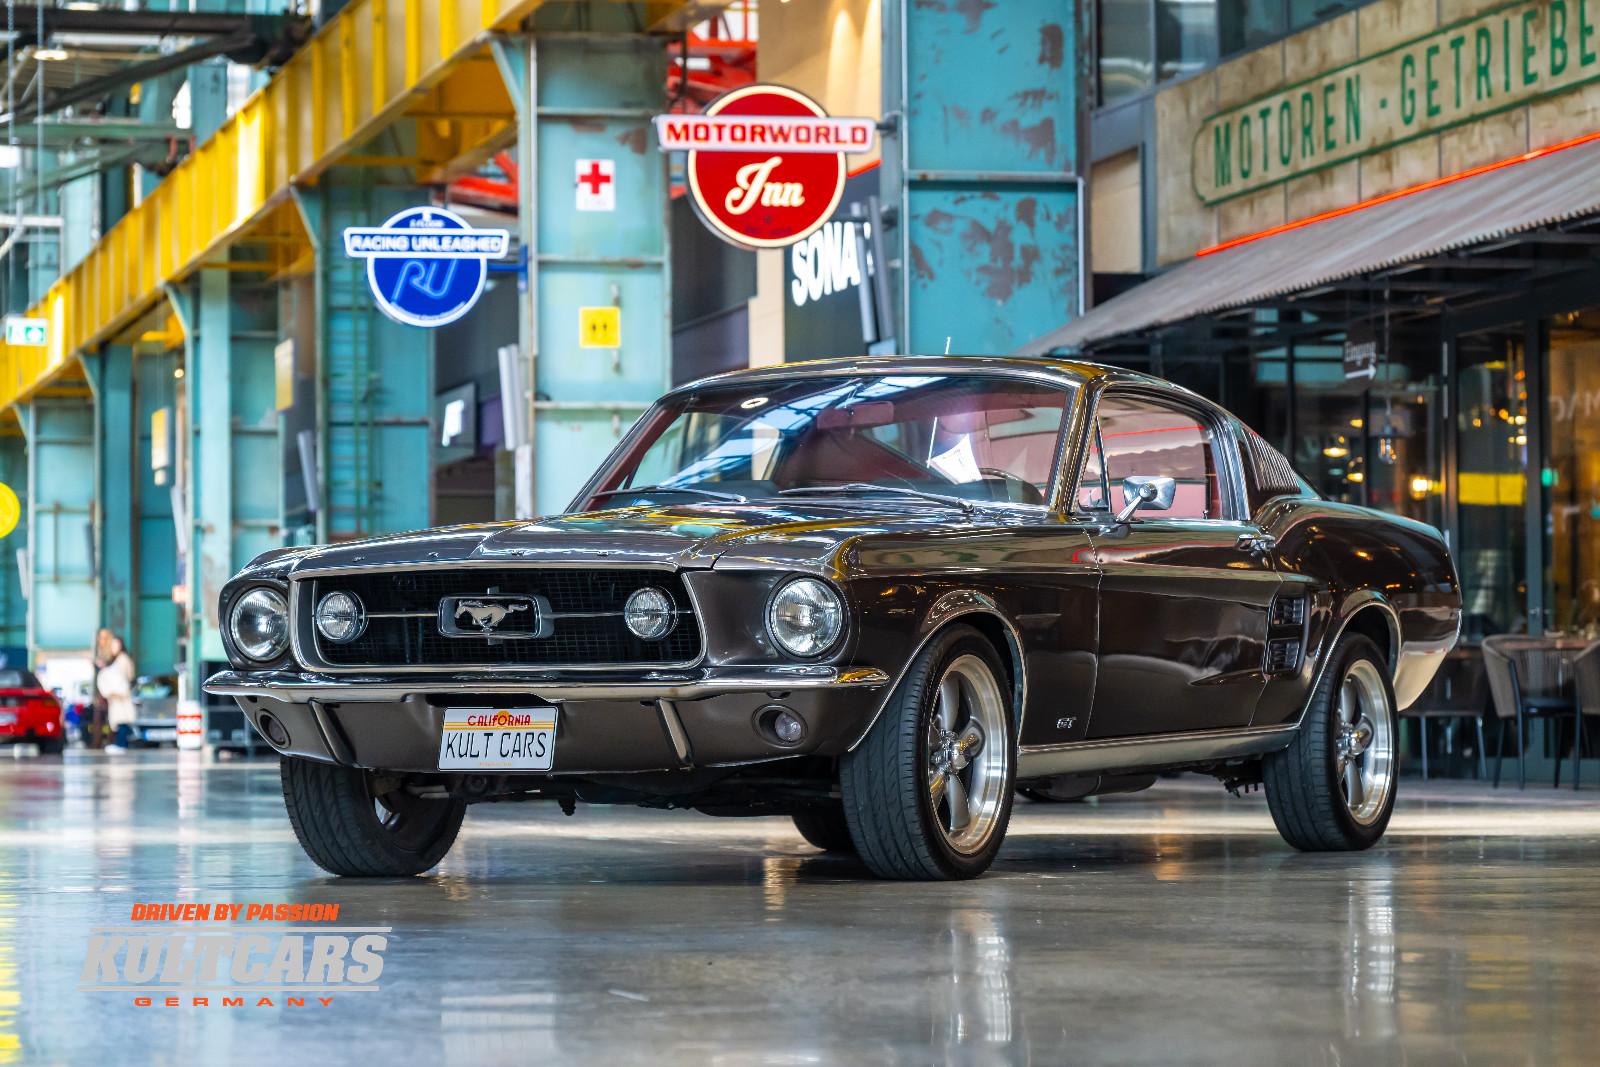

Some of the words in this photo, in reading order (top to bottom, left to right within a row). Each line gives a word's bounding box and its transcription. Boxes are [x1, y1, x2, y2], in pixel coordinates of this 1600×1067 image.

[1214, 74, 1360, 188] MOTOREN
[1401, 0, 1597, 126] GETRIEBE
[666, 123, 867, 144] MOTORWORLD
[725, 156, 805, 215] Inn
[351, 235, 409, 251] RACING
[411, 236, 501, 251] UNLEASHED
[467, 714, 531, 727] CALIFORNIA
[445, 732, 493, 758] KULT
[500, 732, 547, 758] CARS
